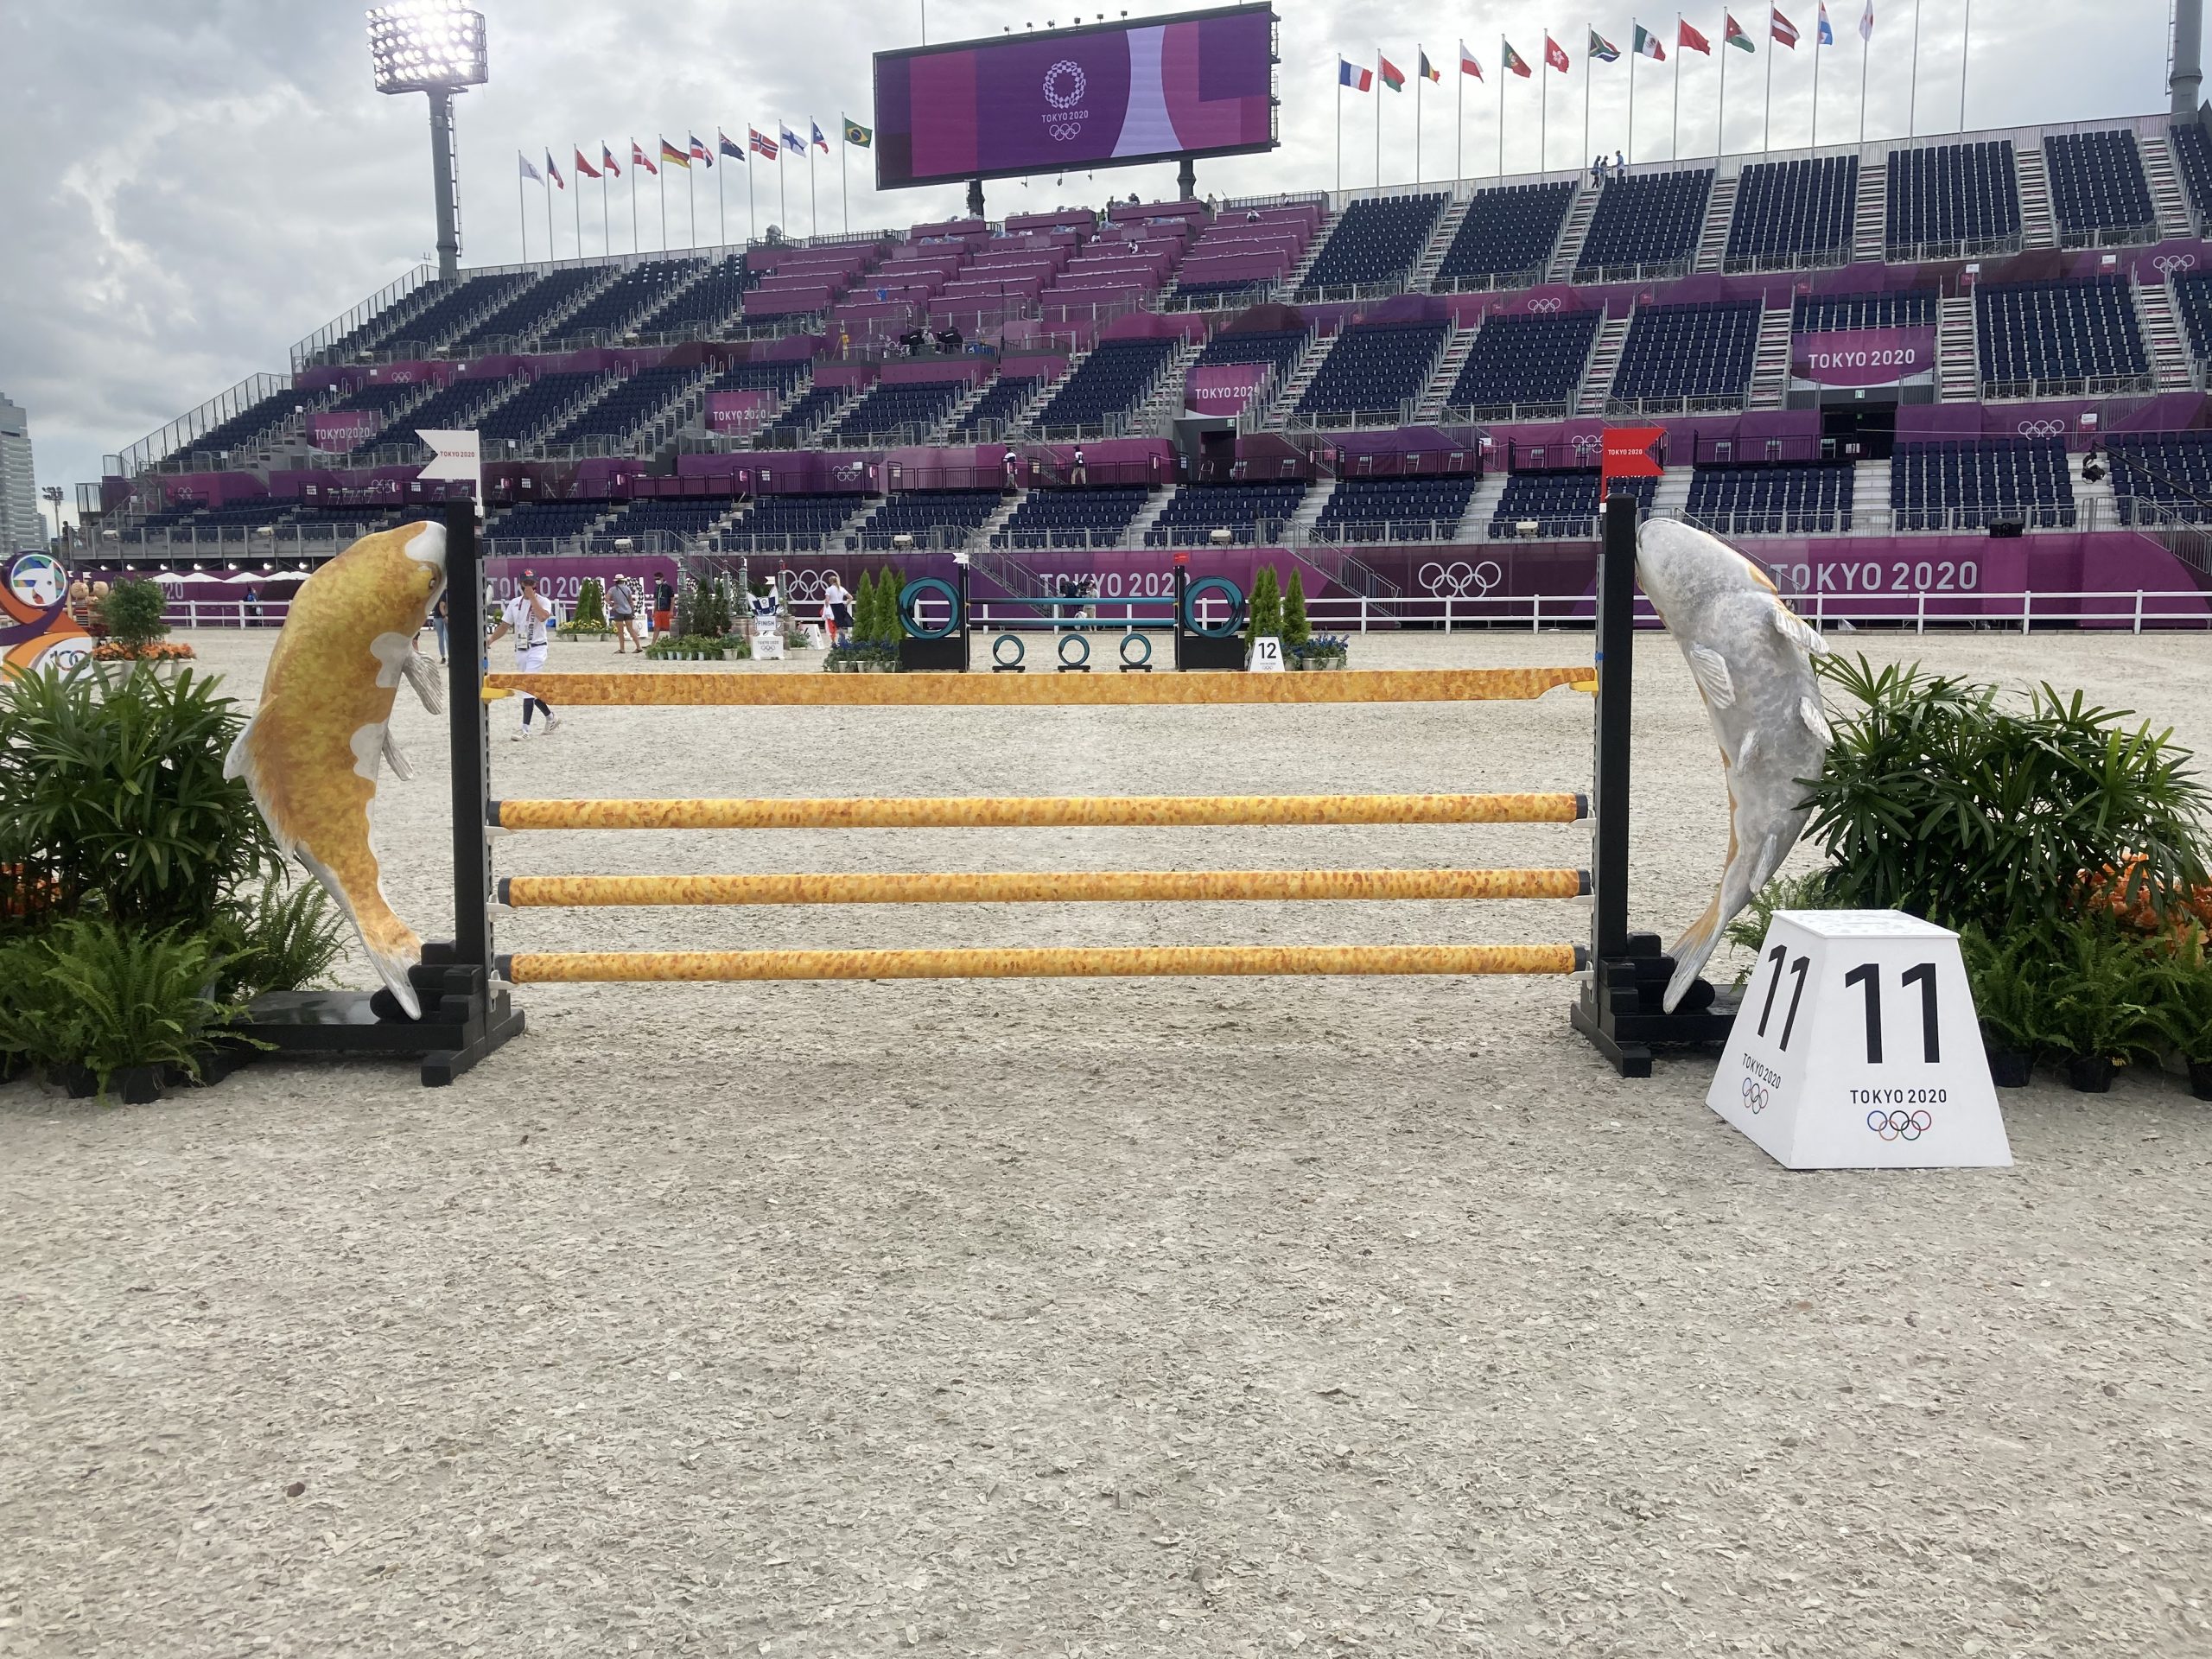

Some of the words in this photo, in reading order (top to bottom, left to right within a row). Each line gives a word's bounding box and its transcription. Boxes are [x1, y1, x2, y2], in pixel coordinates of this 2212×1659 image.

[1041, 112, 1067, 124] TOKYO
[1069, 110, 1089, 120] 2020
[1808, 352, 1866, 369] TOKYO
[1871, 348, 1915, 366] 2020
[1195, 387, 1230, 399] TOKYO
[1233, 385, 1259, 397] 202
[713, 410, 742, 421] TOKYO
[315, 428, 346, 441] TOKYO
[347, 427, 370, 439] 2020
[1770, 563, 1882, 591] TOKYO
[1891, 562, 1977, 590] 2020
[556, 576, 603, 598] 20
[1258, 642, 1277, 659] 12
[1758, 944, 1811, 1052] 11
[1845, 963, 1940, 1064] 11
[1742, 1052, 1764, 1077] TOKYO
[1762, 1067, 1782, 1089] 2020
[1850, 1090, 1904, 1104] TOKYO
[1908, 1089, 1947, 1103] 2020
